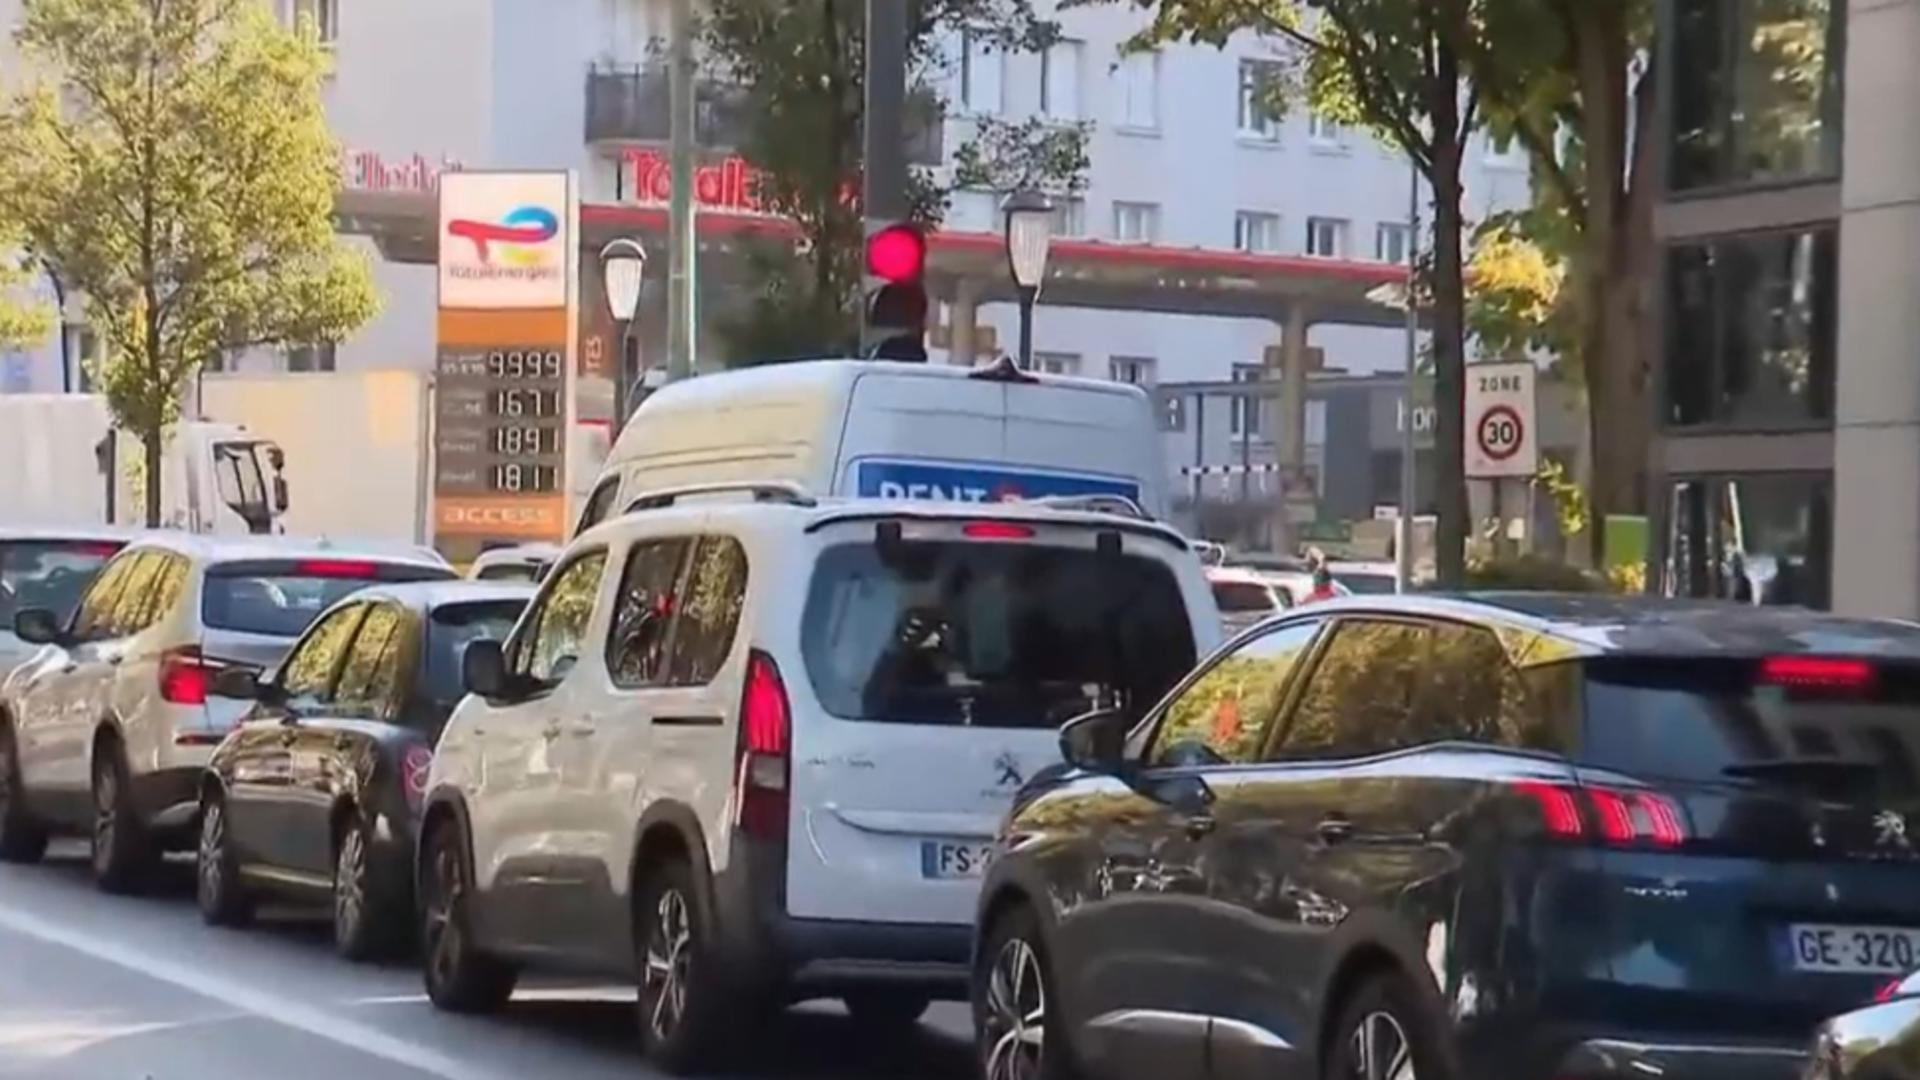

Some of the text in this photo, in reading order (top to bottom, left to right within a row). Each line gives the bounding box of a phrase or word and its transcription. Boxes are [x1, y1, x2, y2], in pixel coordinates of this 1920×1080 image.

[1479, 375, 1521, 392] ZONE
[1487, 421, 1514, 444] 30
[444, 507, 556, 525] access
